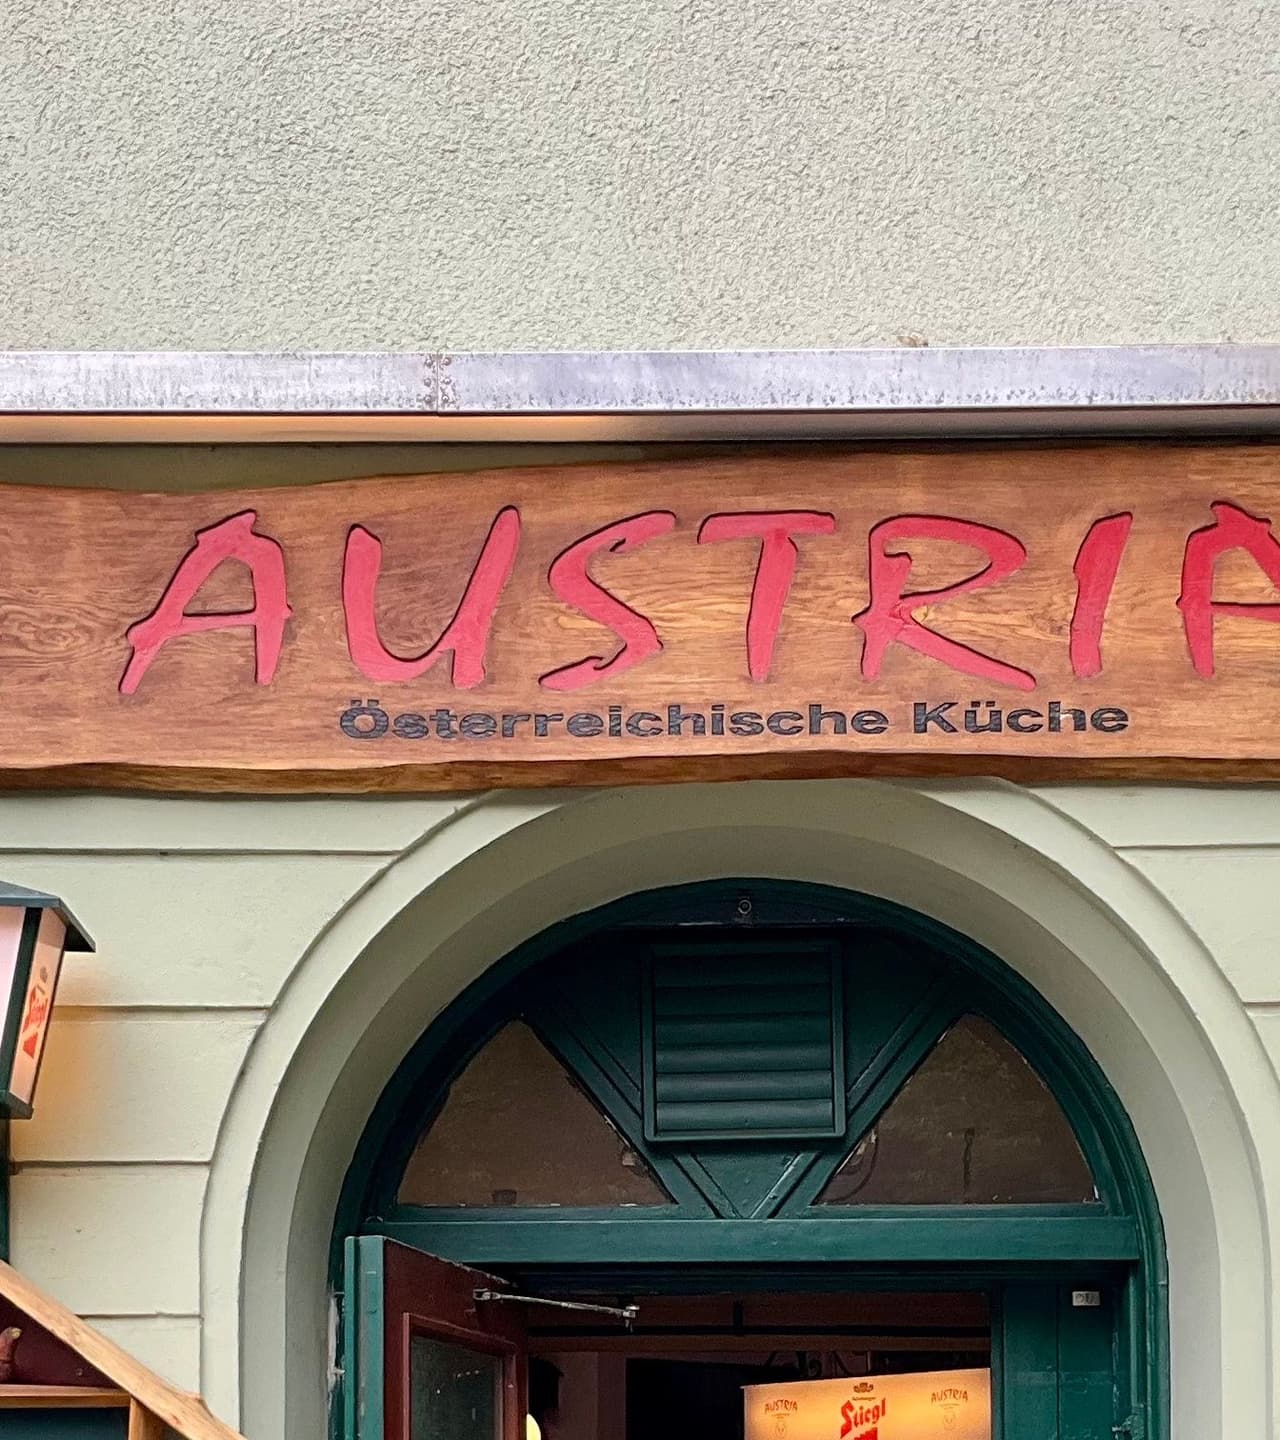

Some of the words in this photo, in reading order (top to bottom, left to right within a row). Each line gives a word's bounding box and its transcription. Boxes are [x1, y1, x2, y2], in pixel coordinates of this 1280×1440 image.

[338, 699, 889, 739] Österreichische
[912, 700, 1129, 734] Küche
[764, 1399, 798, 1415] AUSTRIA
[930, 1388, 969, 1404] AUSTRIA
[840, 1397, 886, 1440] Stiegl
